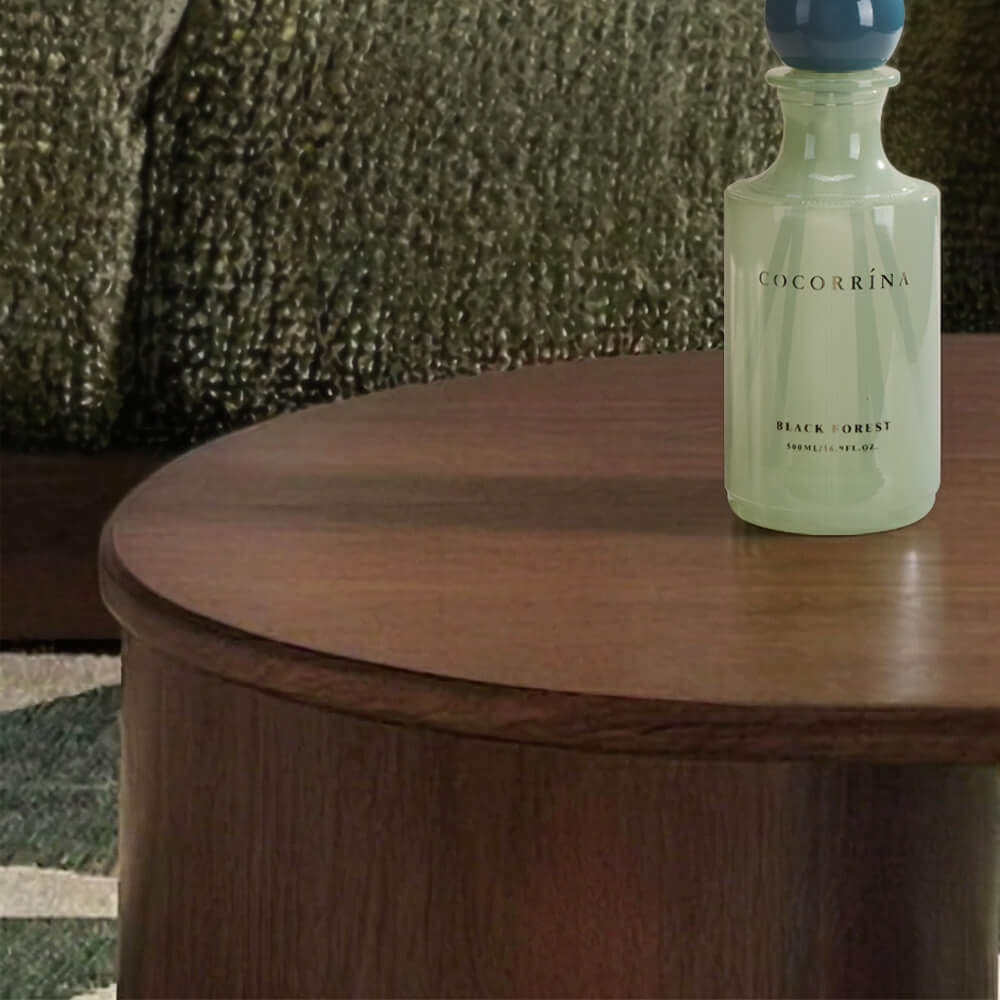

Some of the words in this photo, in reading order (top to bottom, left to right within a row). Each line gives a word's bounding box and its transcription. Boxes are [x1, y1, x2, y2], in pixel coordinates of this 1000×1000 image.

[759, 267, 909, 291] COCORRÍNA
[776, 421, 824, 434] BLACK
[832, 421, 890, 434] FOREST
